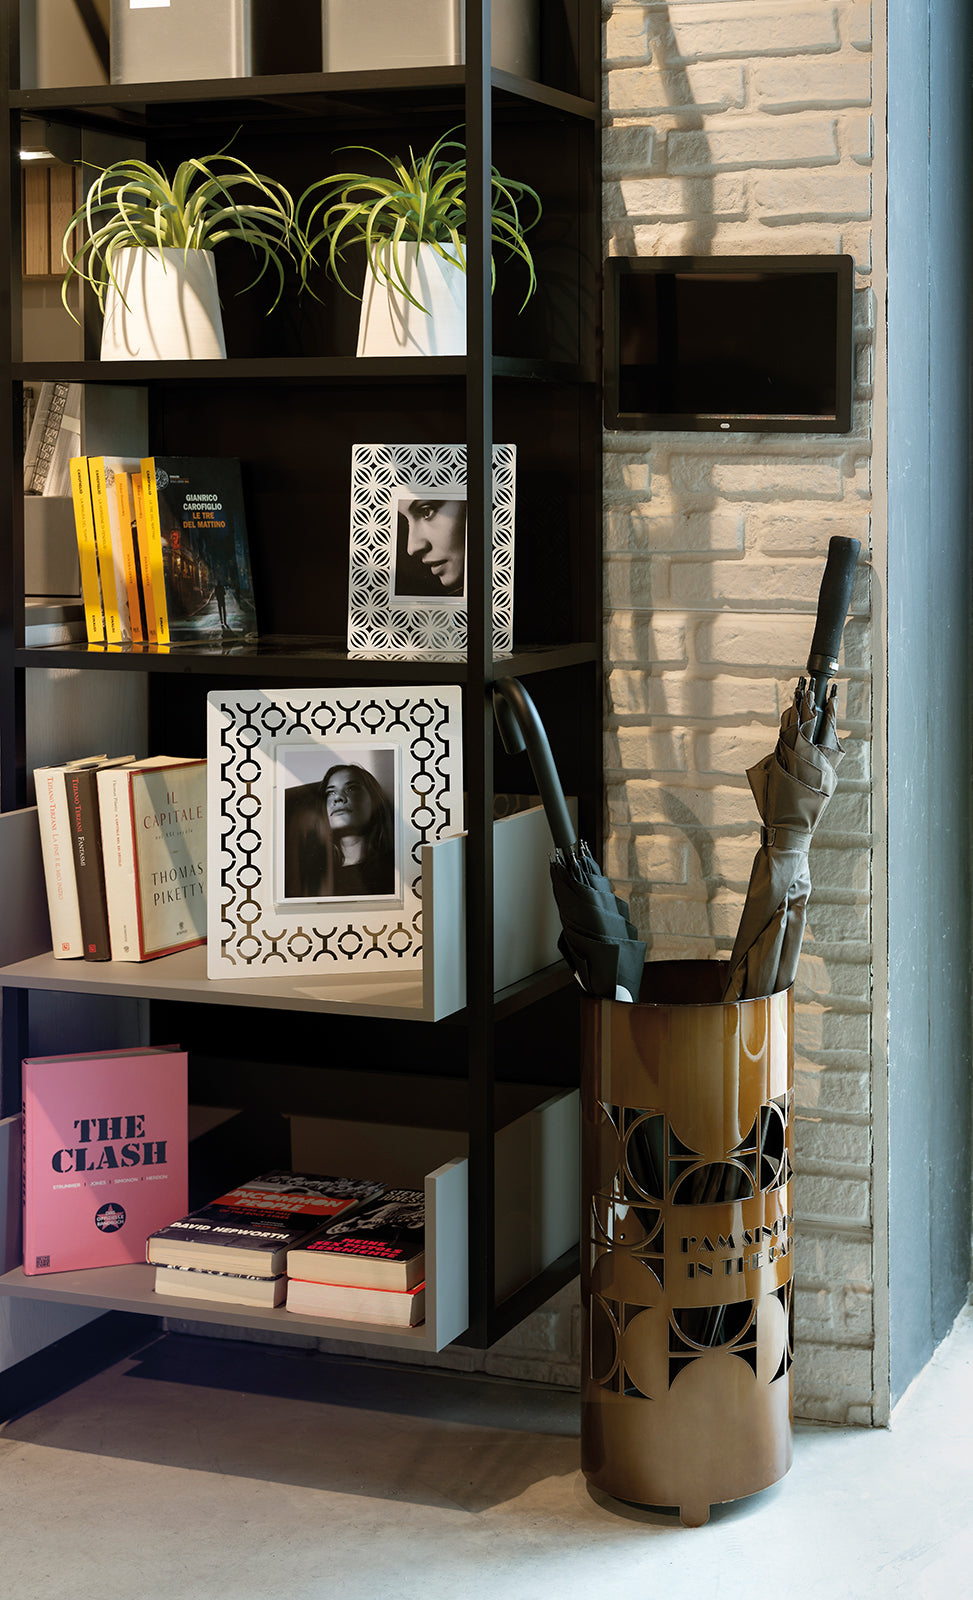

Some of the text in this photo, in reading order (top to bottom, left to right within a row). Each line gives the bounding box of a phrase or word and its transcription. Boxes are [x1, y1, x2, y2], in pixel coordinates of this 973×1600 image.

[183, 503, 222, 511] CAROFIGLIO
[185, 494, 218, 502] GIANRICO
[183, 520, 226, 529] DEL MATTINO
[192, 512, 201, 520] LE
[167, 791, 178, 805] IL
[49, 803, 57, 831] TERZANI
[72, 777, 86, 867] TIZIANO TERZANI FANTASMI
[143, 805, 203, 829] CAPITALE
[152, 862, 204, 886] THOMAS
[153, 882, 205, 906] PIKETTY
[74, 1114, 146, 1143] THE
[51, 1140, 168, 1173] CLASH
[226, 1190, 344, 1207] UNCOMMON
[234, 1199, 305, 1212] PEOPLE
[169, 1221, 290, 1240] DAVID HEPWORTH
[687, 1261, 714, 1279] IN
[720, 1251, 763, 1275] THE
